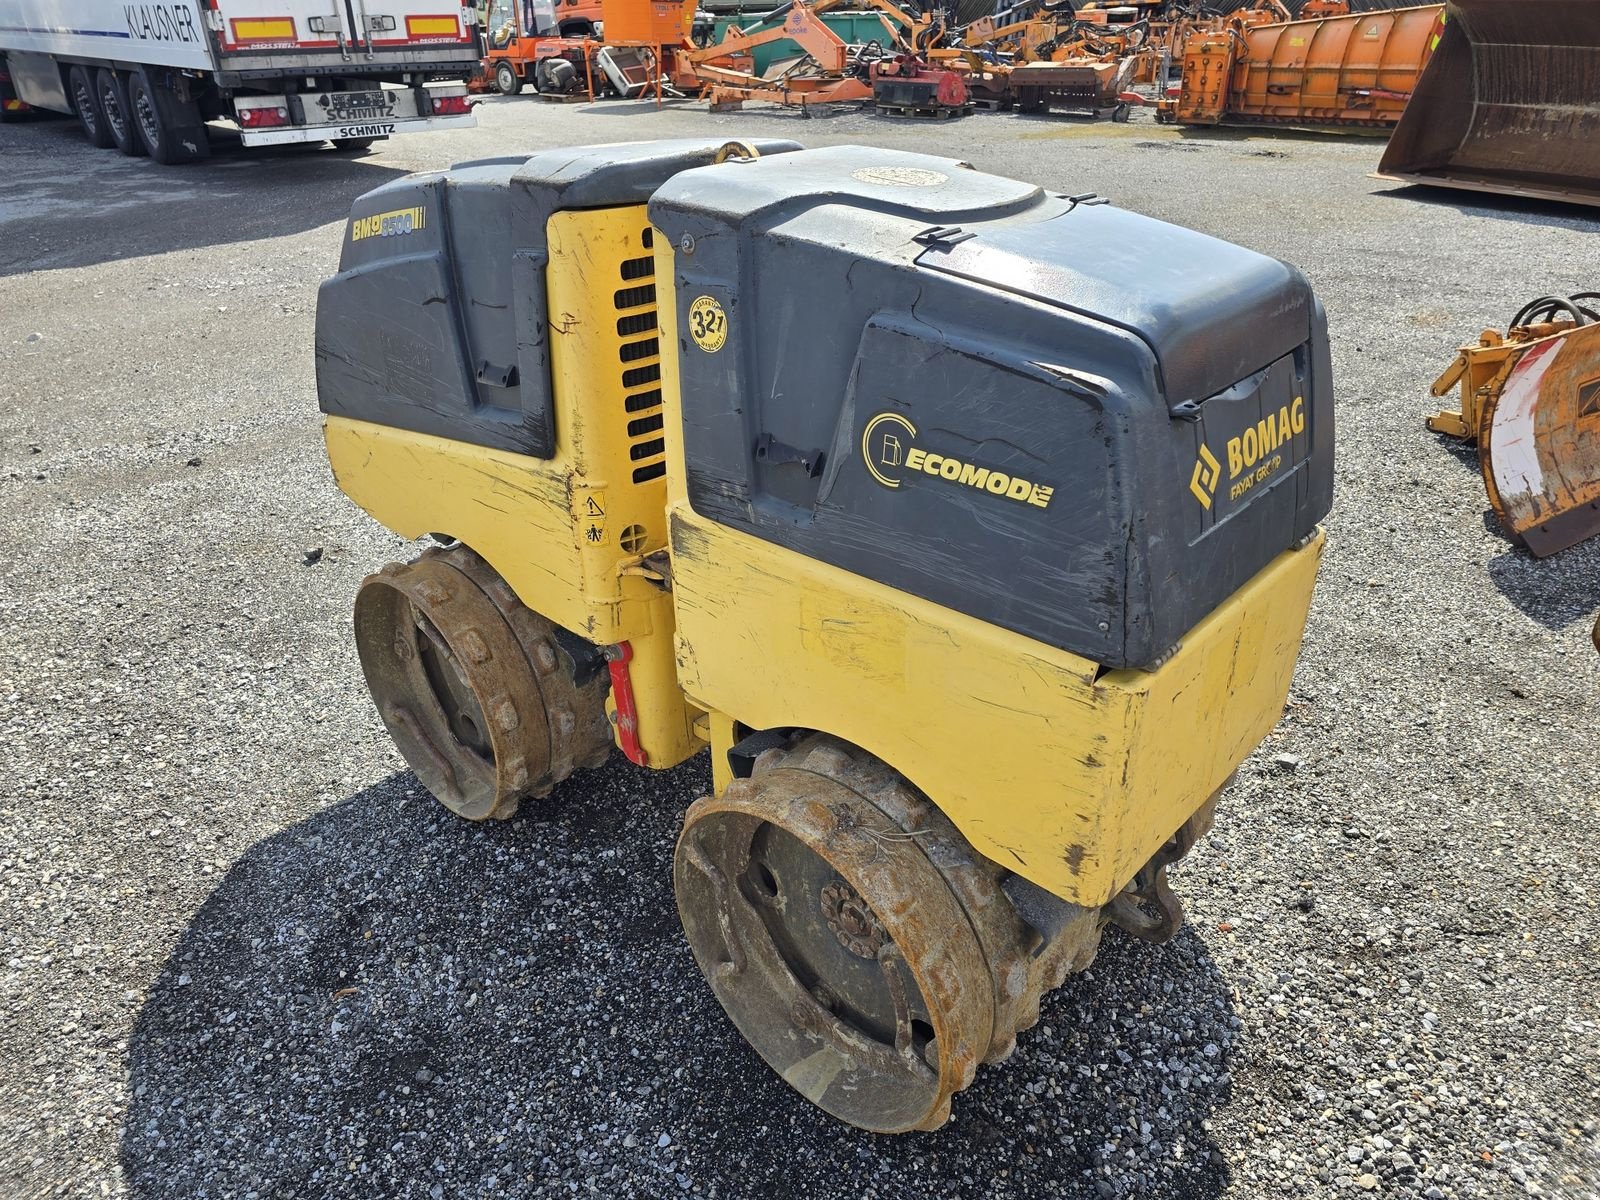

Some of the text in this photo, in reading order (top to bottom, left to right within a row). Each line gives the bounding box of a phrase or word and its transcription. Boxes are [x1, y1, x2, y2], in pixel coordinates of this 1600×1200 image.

[123, 5, 199, 42] KLAUSNER
[326, 106, 394, 121] SCHMITZ
[340, 124, 395, 137] SCHMITZ
[692, 309, 724, 338] 321
[1227, 396, 1304, 480] BOMAG
[904, 447, 1054, 508] ECOMODE
[1230, 473, 1255, 501] FAYAT
